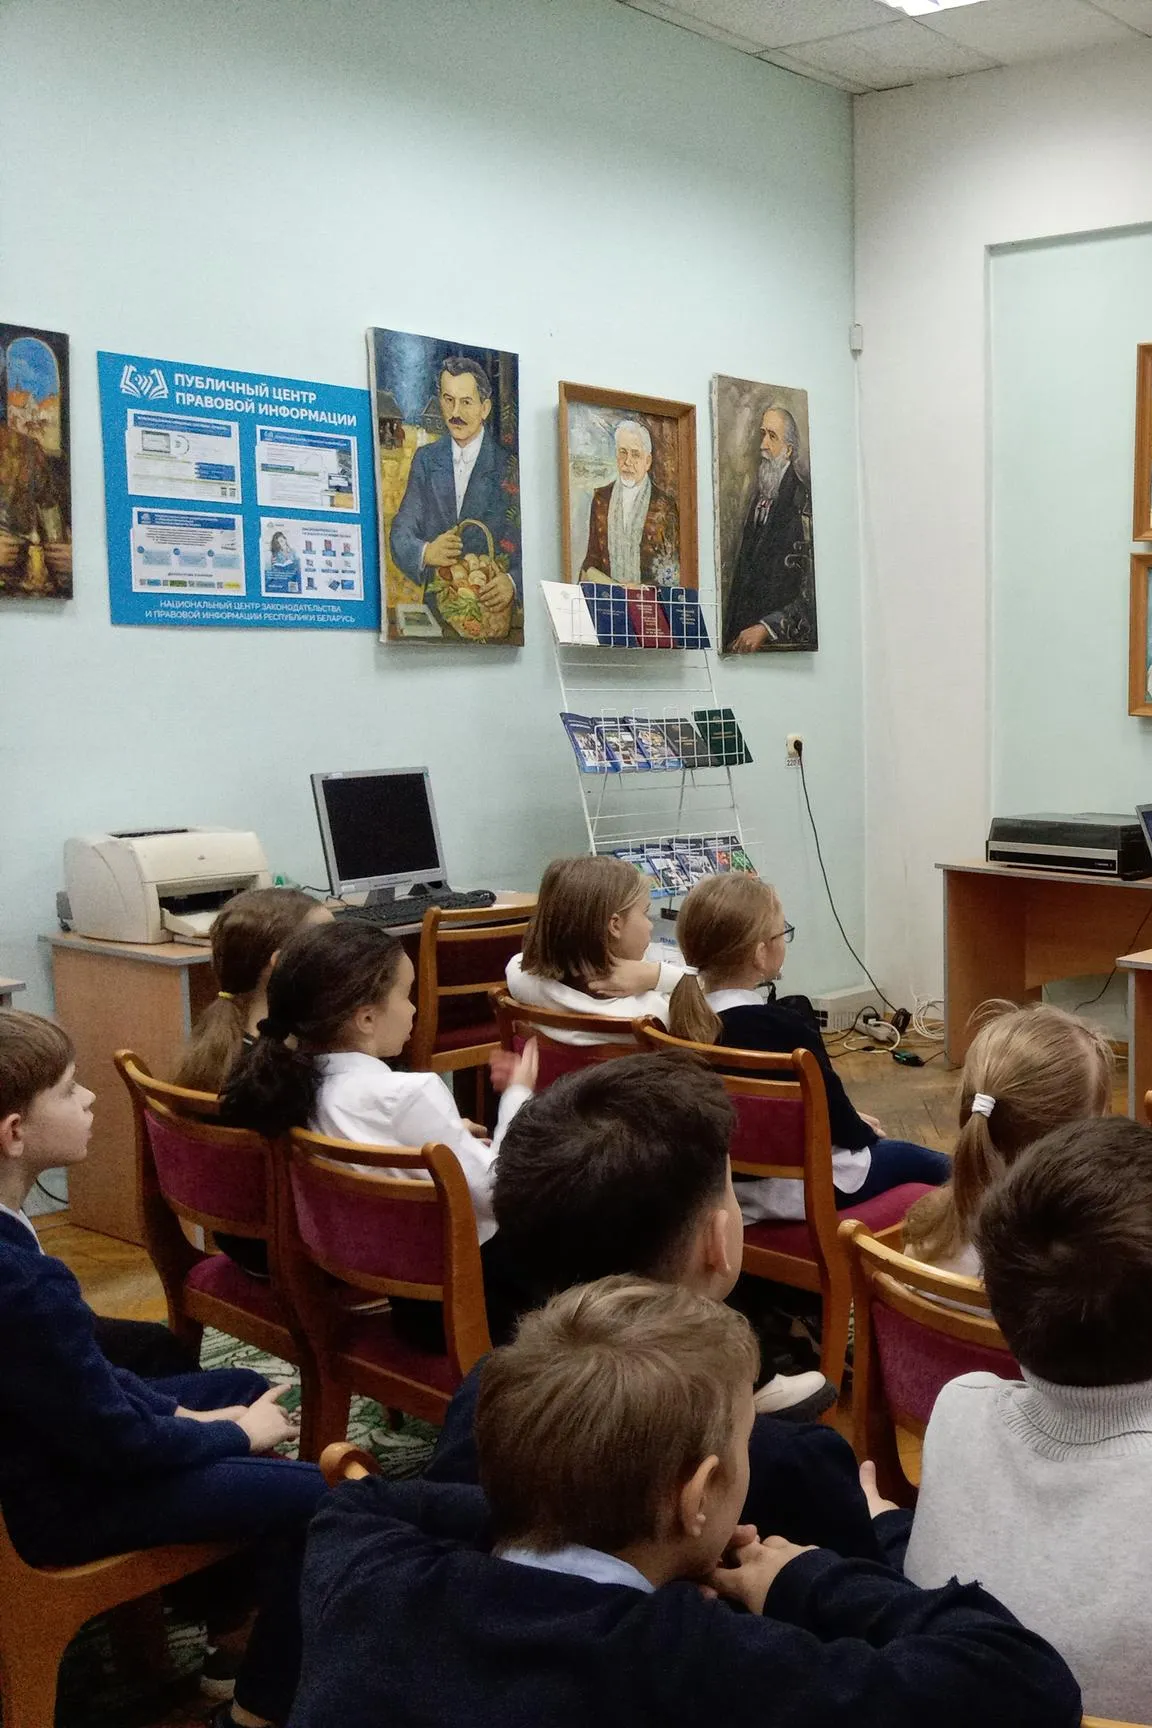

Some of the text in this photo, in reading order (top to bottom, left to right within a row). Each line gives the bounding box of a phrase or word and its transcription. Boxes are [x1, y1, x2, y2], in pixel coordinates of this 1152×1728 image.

[174, 373, 317, 404] ПУБЛИЧНЫЙ ЦЕНТР
[175, 392, 357, 427] ПРАВОВОЙ ИНФОРМАЦИИ
[153, 610, 200, 619] ПРАВОВОЙ
[202, 612, 262, 621] ИНФОРМАЦИИ
[263, 613, 316, 622] РЕСПУБЛИКИ
[317, 615, 356, 623] БЕЛАРУСЬ
[160, 600, 341, 613] НАЦИОНАЛЬНЫЙ ЦЕНТР ЗАКОНОДАТЕЛЬСТВА
